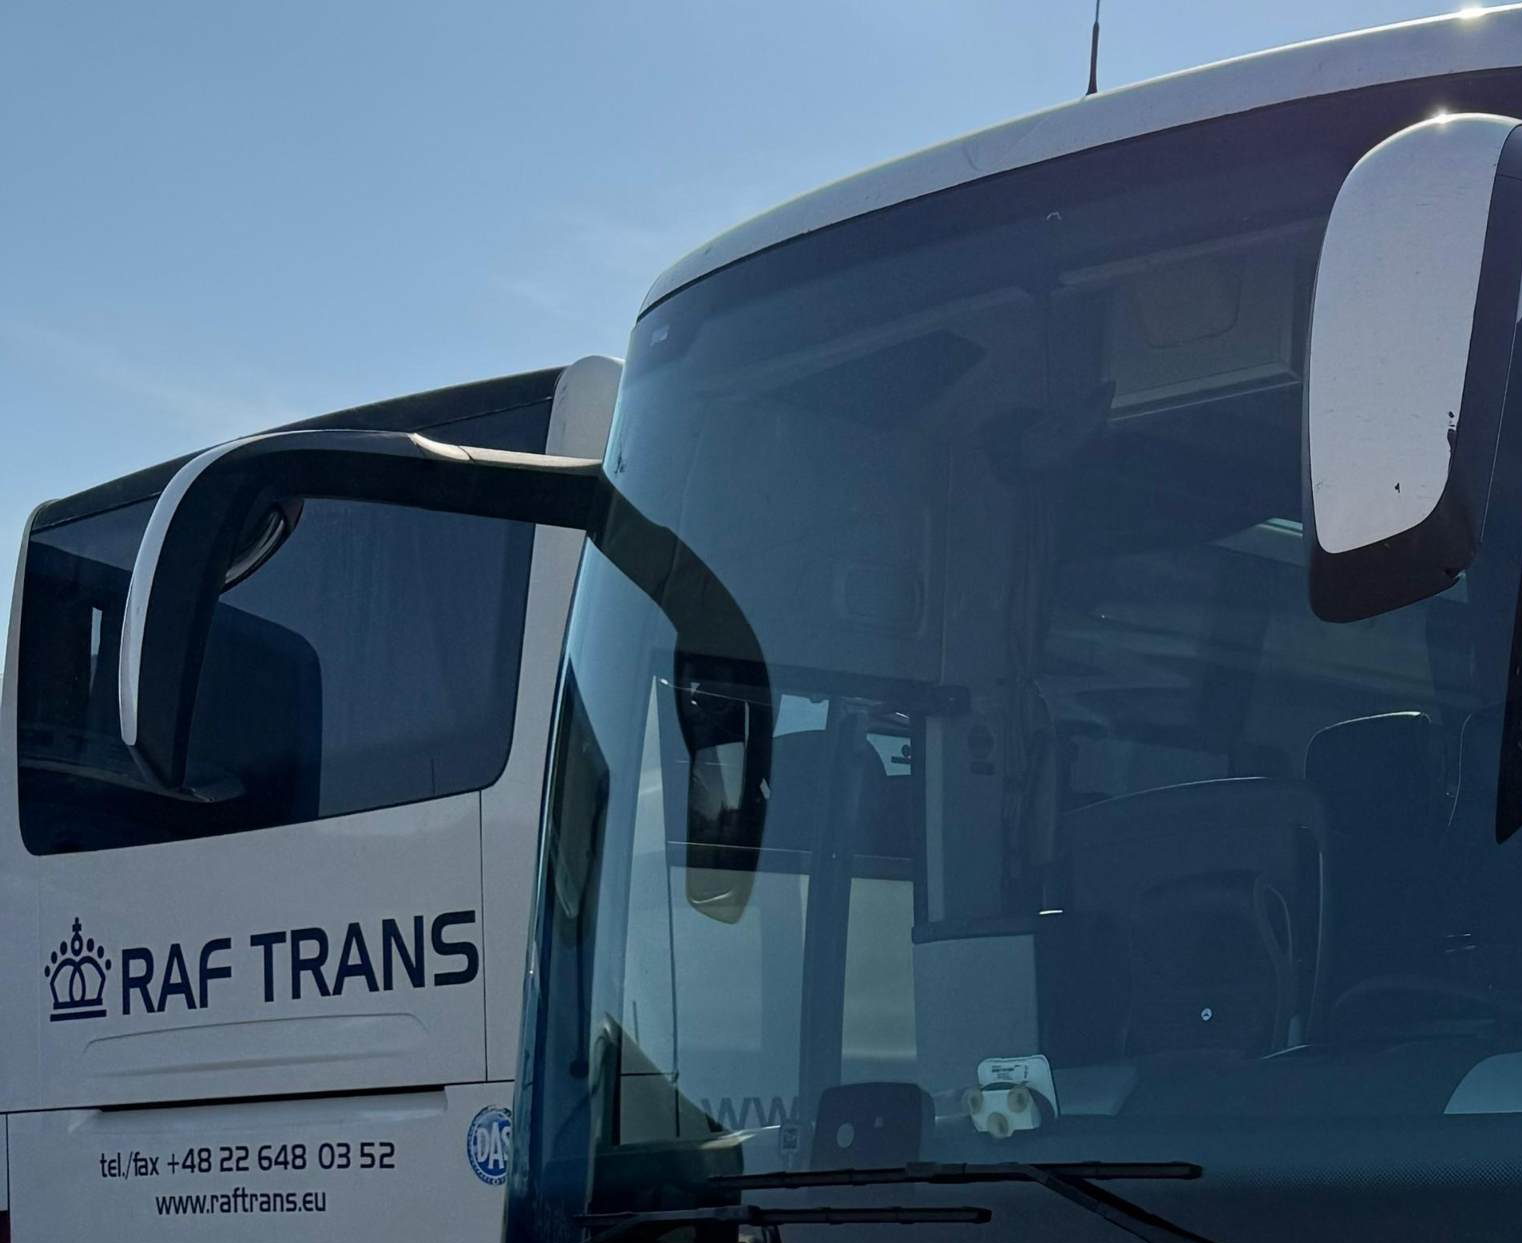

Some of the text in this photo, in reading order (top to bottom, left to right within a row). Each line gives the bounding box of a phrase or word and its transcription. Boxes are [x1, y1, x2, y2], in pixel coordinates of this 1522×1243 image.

[121, 910, 480, 1016] RAF TRANS
[100, 1142, 396, 1180] tel./fax +48 22 648 03 52
[155, 1186, 327, 1216] www.raftrans.eu
